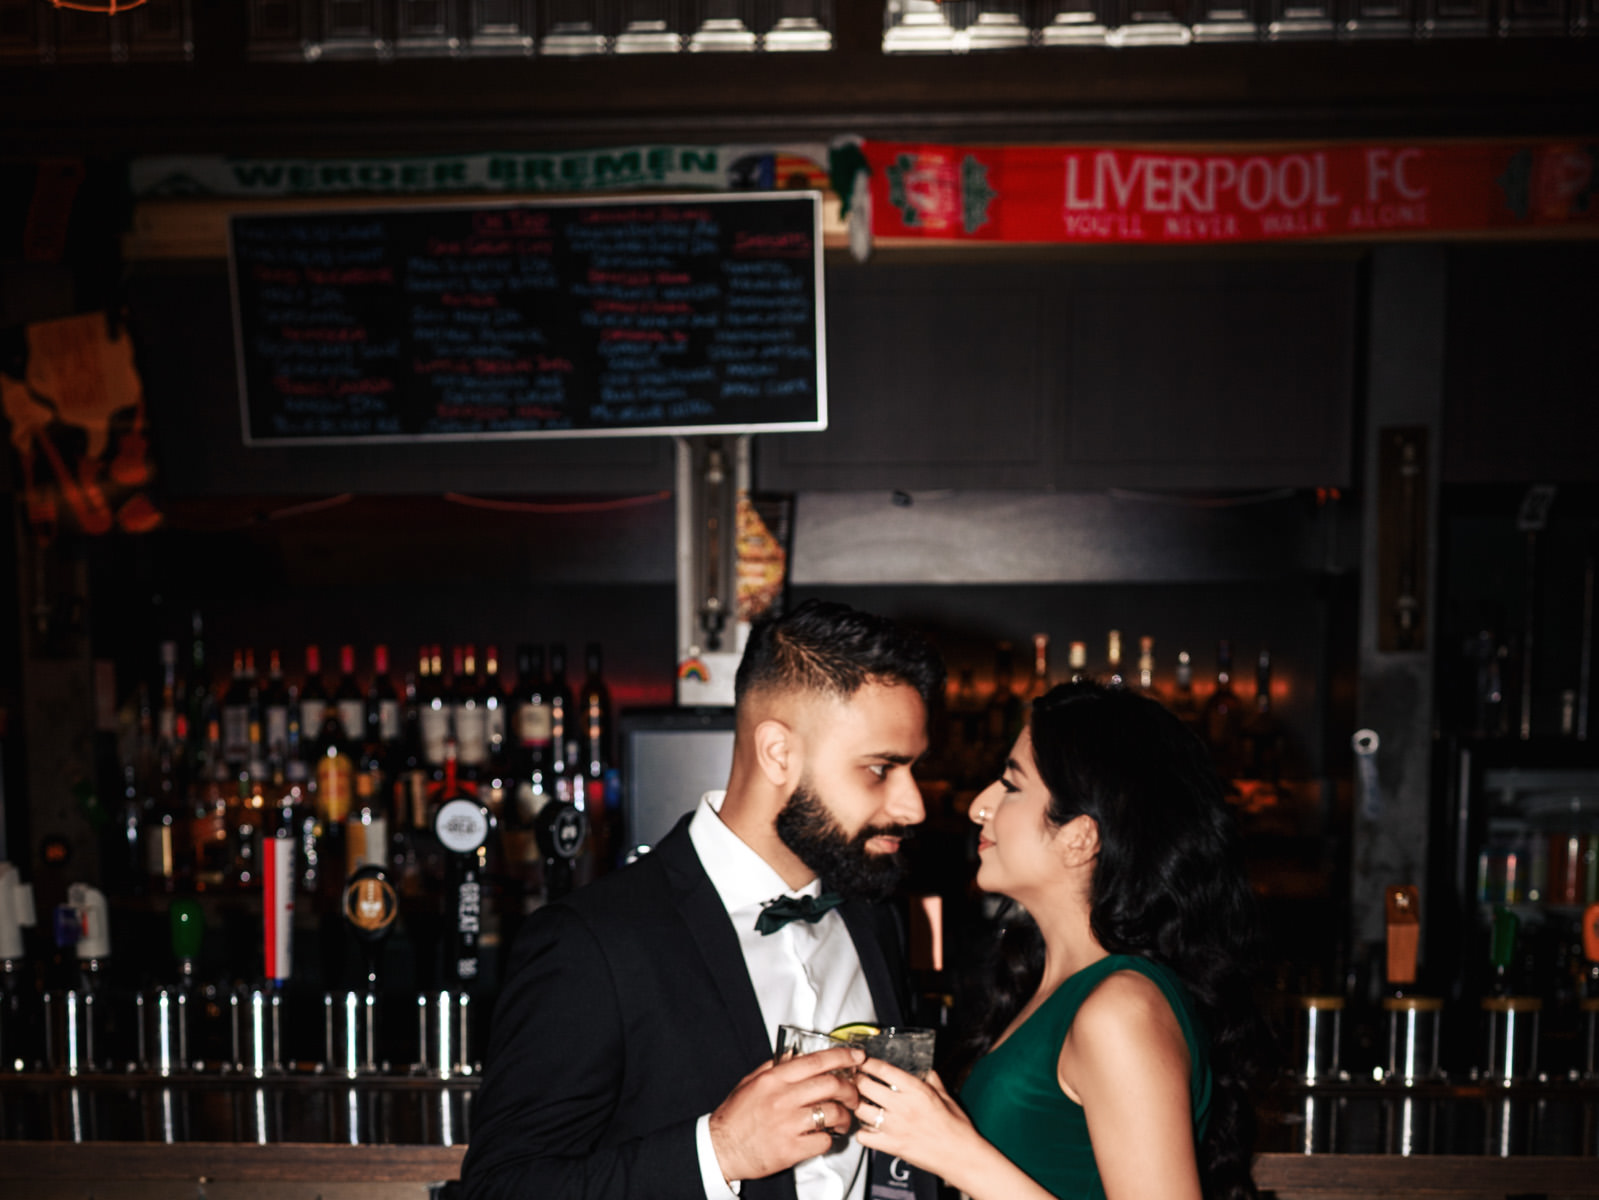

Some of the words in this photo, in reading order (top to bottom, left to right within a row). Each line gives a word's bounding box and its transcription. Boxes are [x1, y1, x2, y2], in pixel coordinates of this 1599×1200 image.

[234, 163, 467, 187] WERDER
[489, 151, 717, 181] BREMEN
[1065, 151, 1342, 213] LIVERPOOL
[1366, 148, 1427, 203] FC
